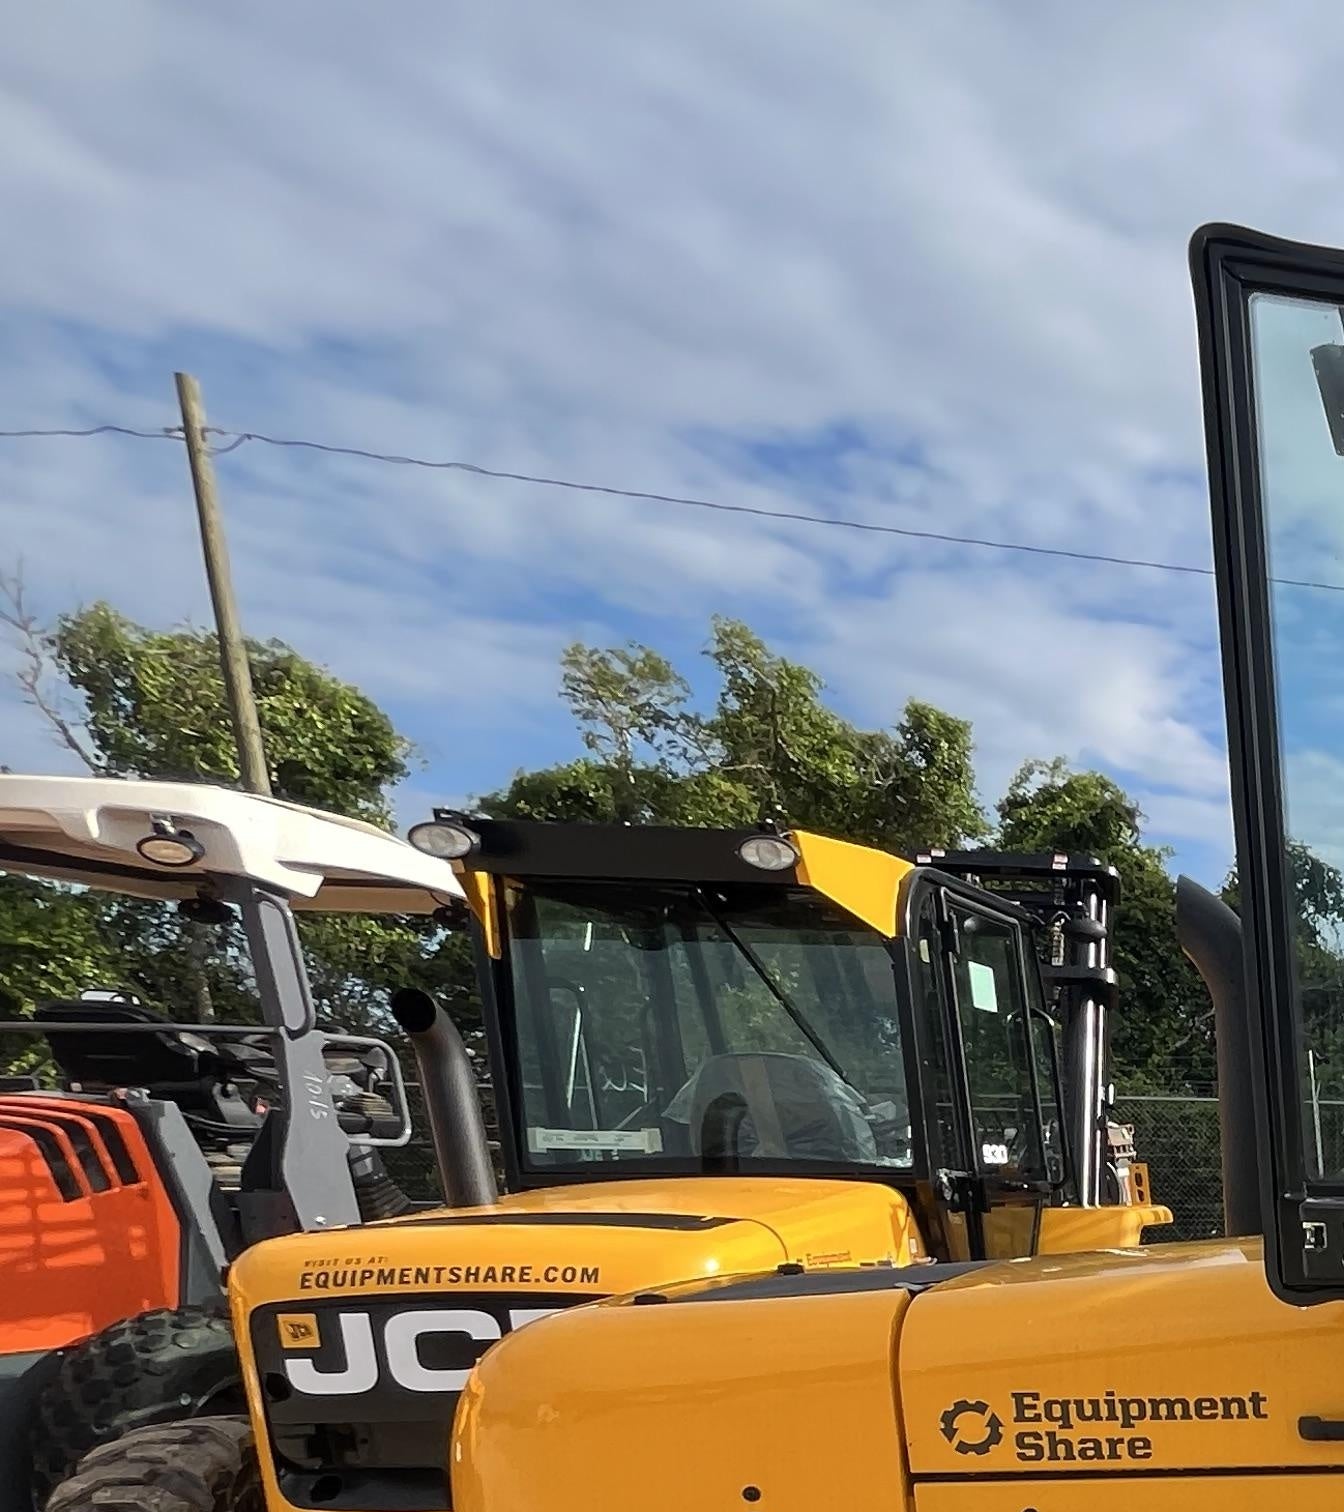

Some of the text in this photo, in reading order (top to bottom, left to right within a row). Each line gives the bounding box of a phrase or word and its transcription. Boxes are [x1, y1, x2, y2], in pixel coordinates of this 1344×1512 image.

[344, 1256, 362, 1266] US
[299, 1265, 600, 1290] EQUIPMENTSHARE.COM
[284, 1309, 563, 1395] JC
[1010, 1390, 1269, 1429] Equipment
[1015, 1430, 1153, 1462] Share
